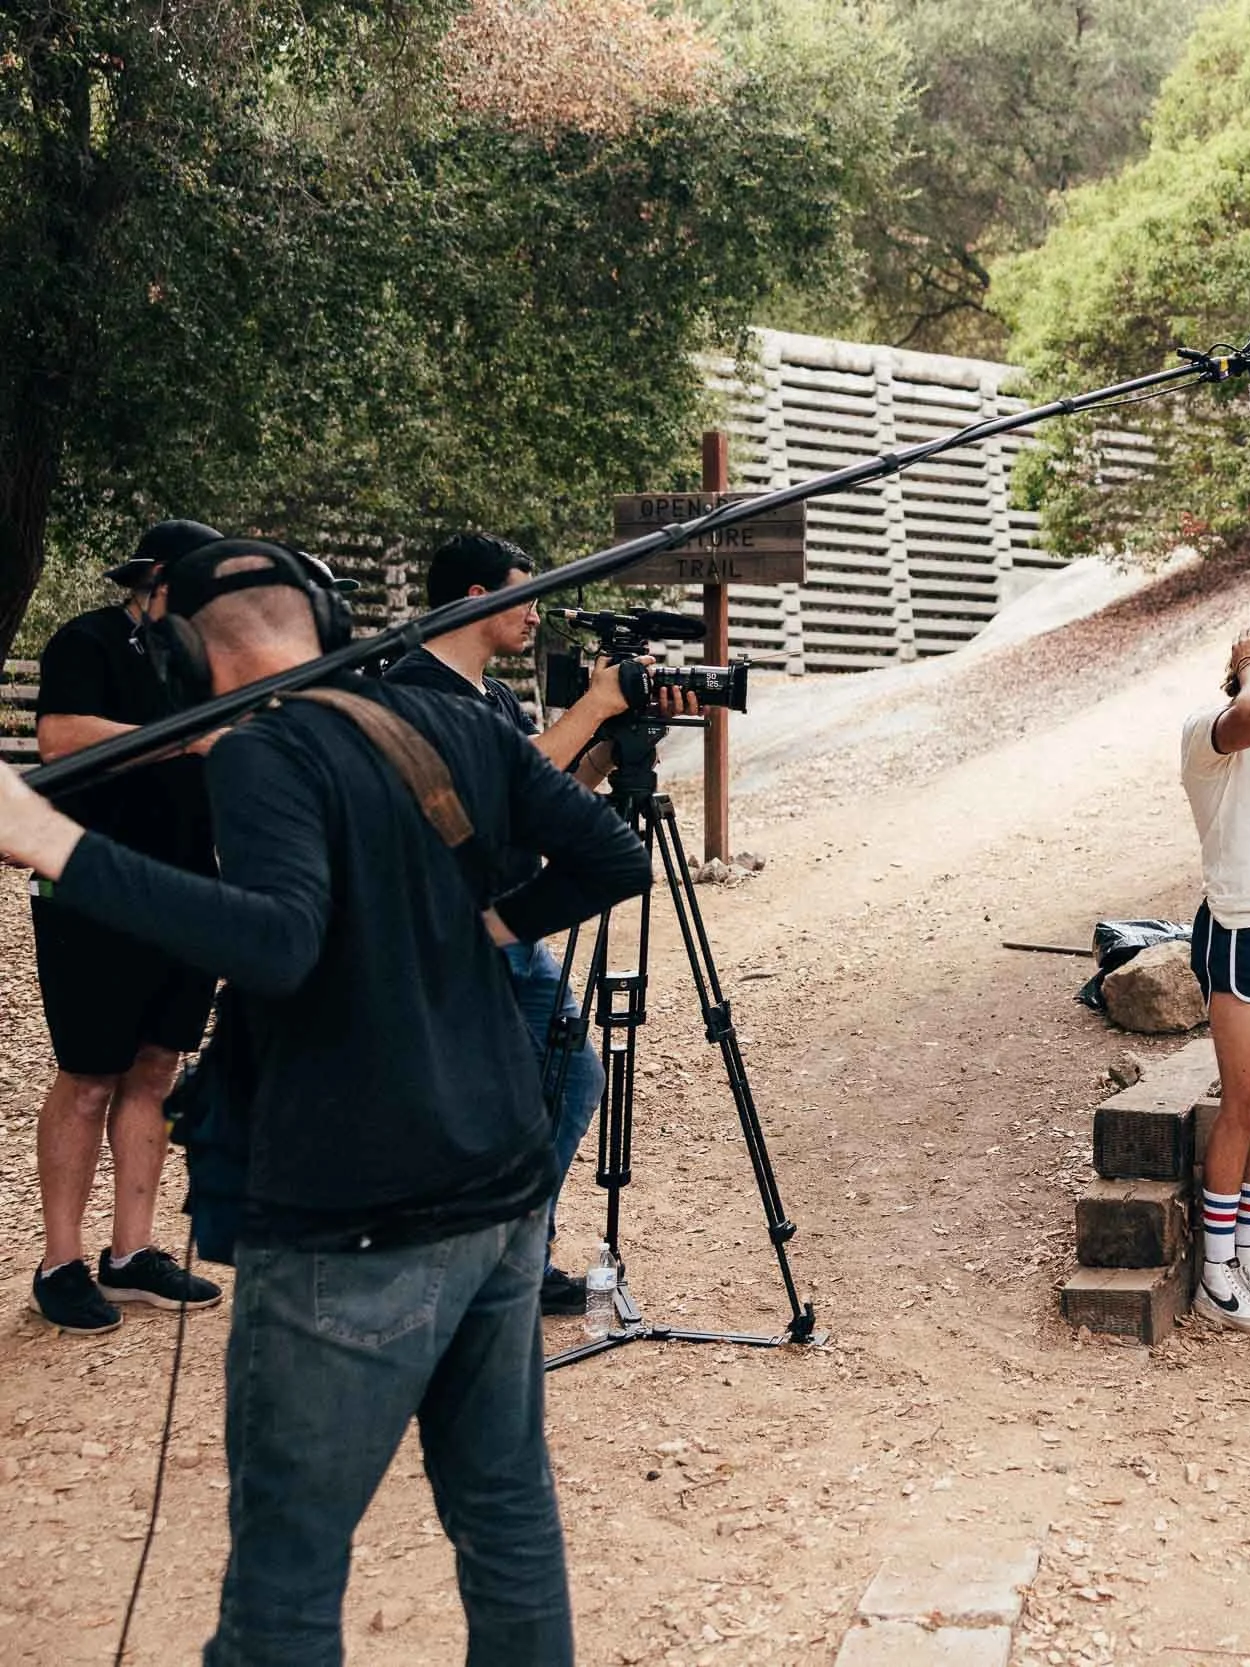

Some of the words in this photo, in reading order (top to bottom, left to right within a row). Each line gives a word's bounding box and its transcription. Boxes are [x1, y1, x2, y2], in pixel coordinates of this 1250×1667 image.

[641, 498, 701, 518] OPEN
[677, 559, 743, 578] TRAIL
[706, 672, 717, 680] 50
[706, 680, 719, 688] 125
